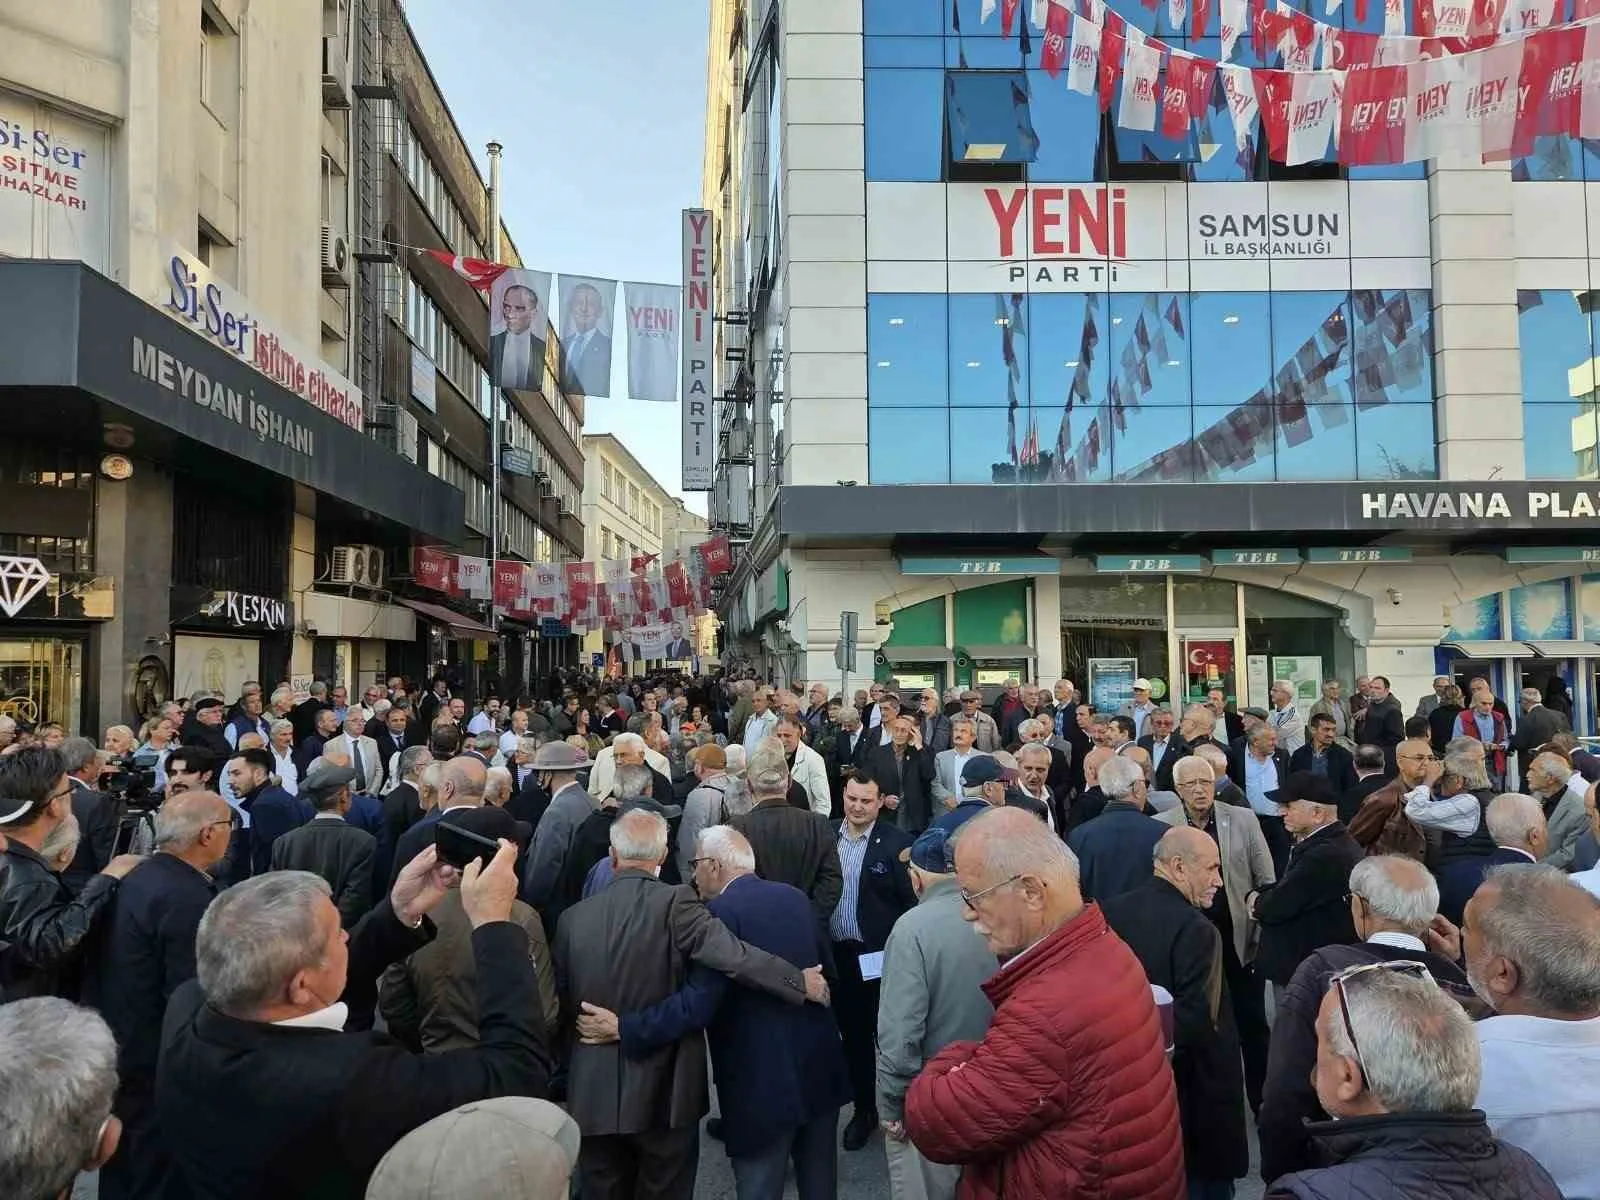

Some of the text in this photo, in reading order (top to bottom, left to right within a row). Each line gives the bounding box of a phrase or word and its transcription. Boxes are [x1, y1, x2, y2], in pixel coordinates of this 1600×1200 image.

[1199, 213, 1339, 238] SAMSUN
[1204, 239, 1331, 258] İL BAŞKANLIĞI
[132, 336, 313, 457] MEYDAN İŞHANI
[1362, 492, 1600, 518] HAVANA PLA
[1235, 552, 1278, 563] TEB
[1340, 550, 1381, 561] TEB
[1582, 550, 1600, 561] DE
[960, 561, 1001, 573] TEB
[1128, 559, 1171, 570] TEB
